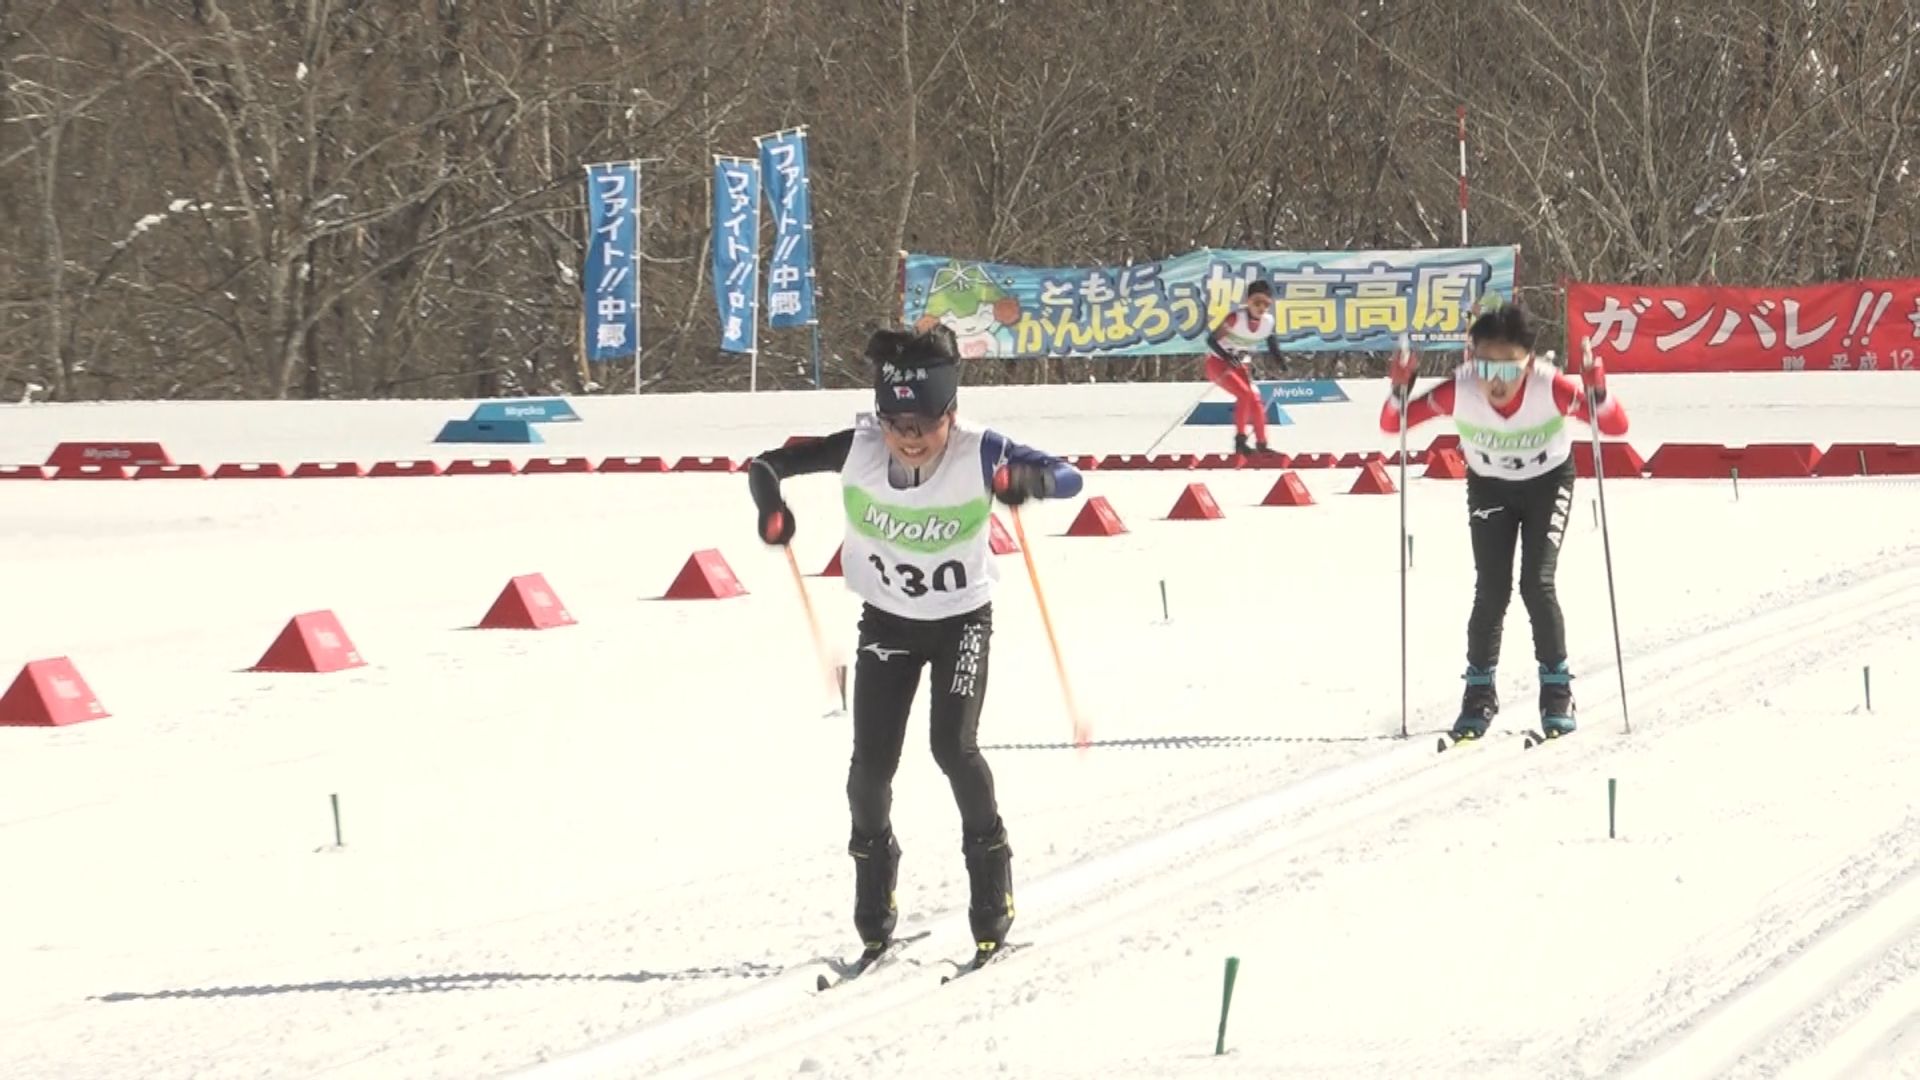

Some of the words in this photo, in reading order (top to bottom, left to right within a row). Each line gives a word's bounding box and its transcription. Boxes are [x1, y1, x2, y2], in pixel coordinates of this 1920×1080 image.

[1040, 266, 1155, 305] ともに
[1017, 288, 1199, 354] がんばろう
[1273, 386, 1314, 399] Myoko
[864, 503, 961, 542] Myoko
[868, 554, 967, 597] 130
